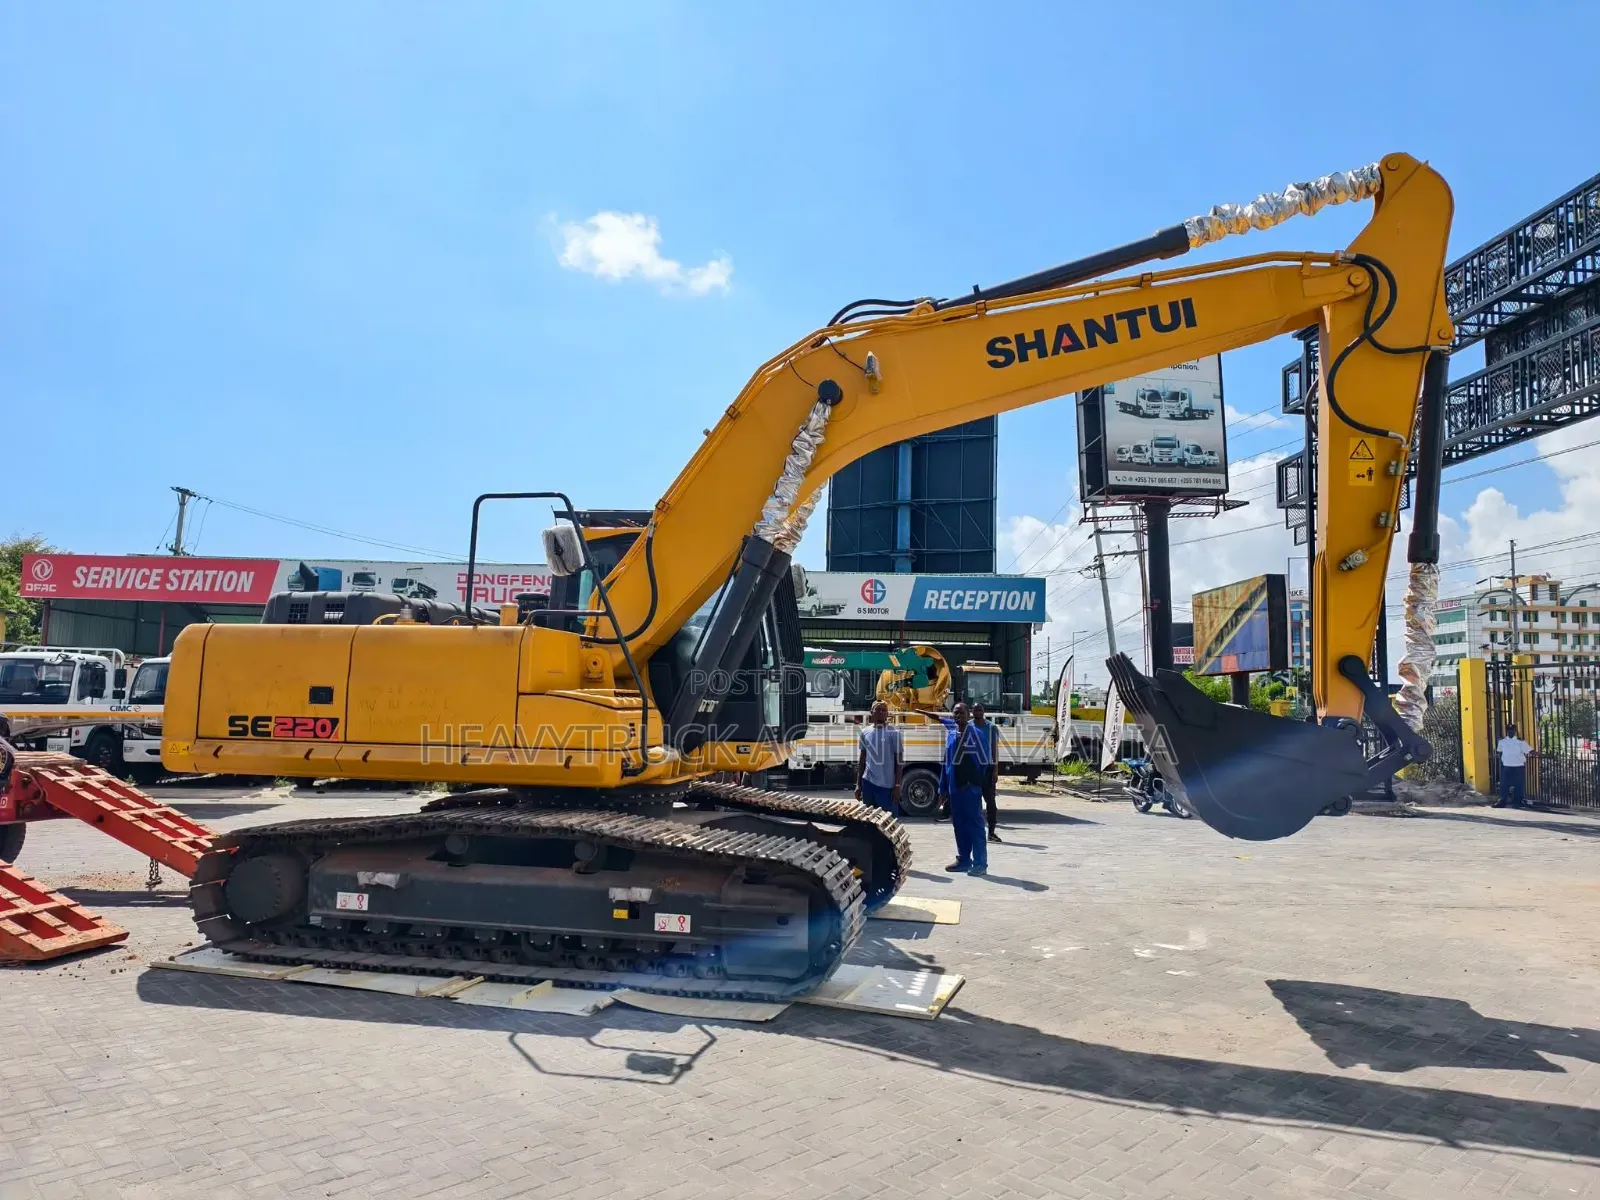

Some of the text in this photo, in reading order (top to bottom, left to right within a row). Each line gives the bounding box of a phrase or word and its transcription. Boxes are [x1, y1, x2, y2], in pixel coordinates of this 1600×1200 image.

[986, 298, 1198, 369] SHANTUI
[72, 565, 255, 593] SERVICE STATION
[923, 589, 1037, 611] RECEPTION
[227, 715, 333, 739] SE220
